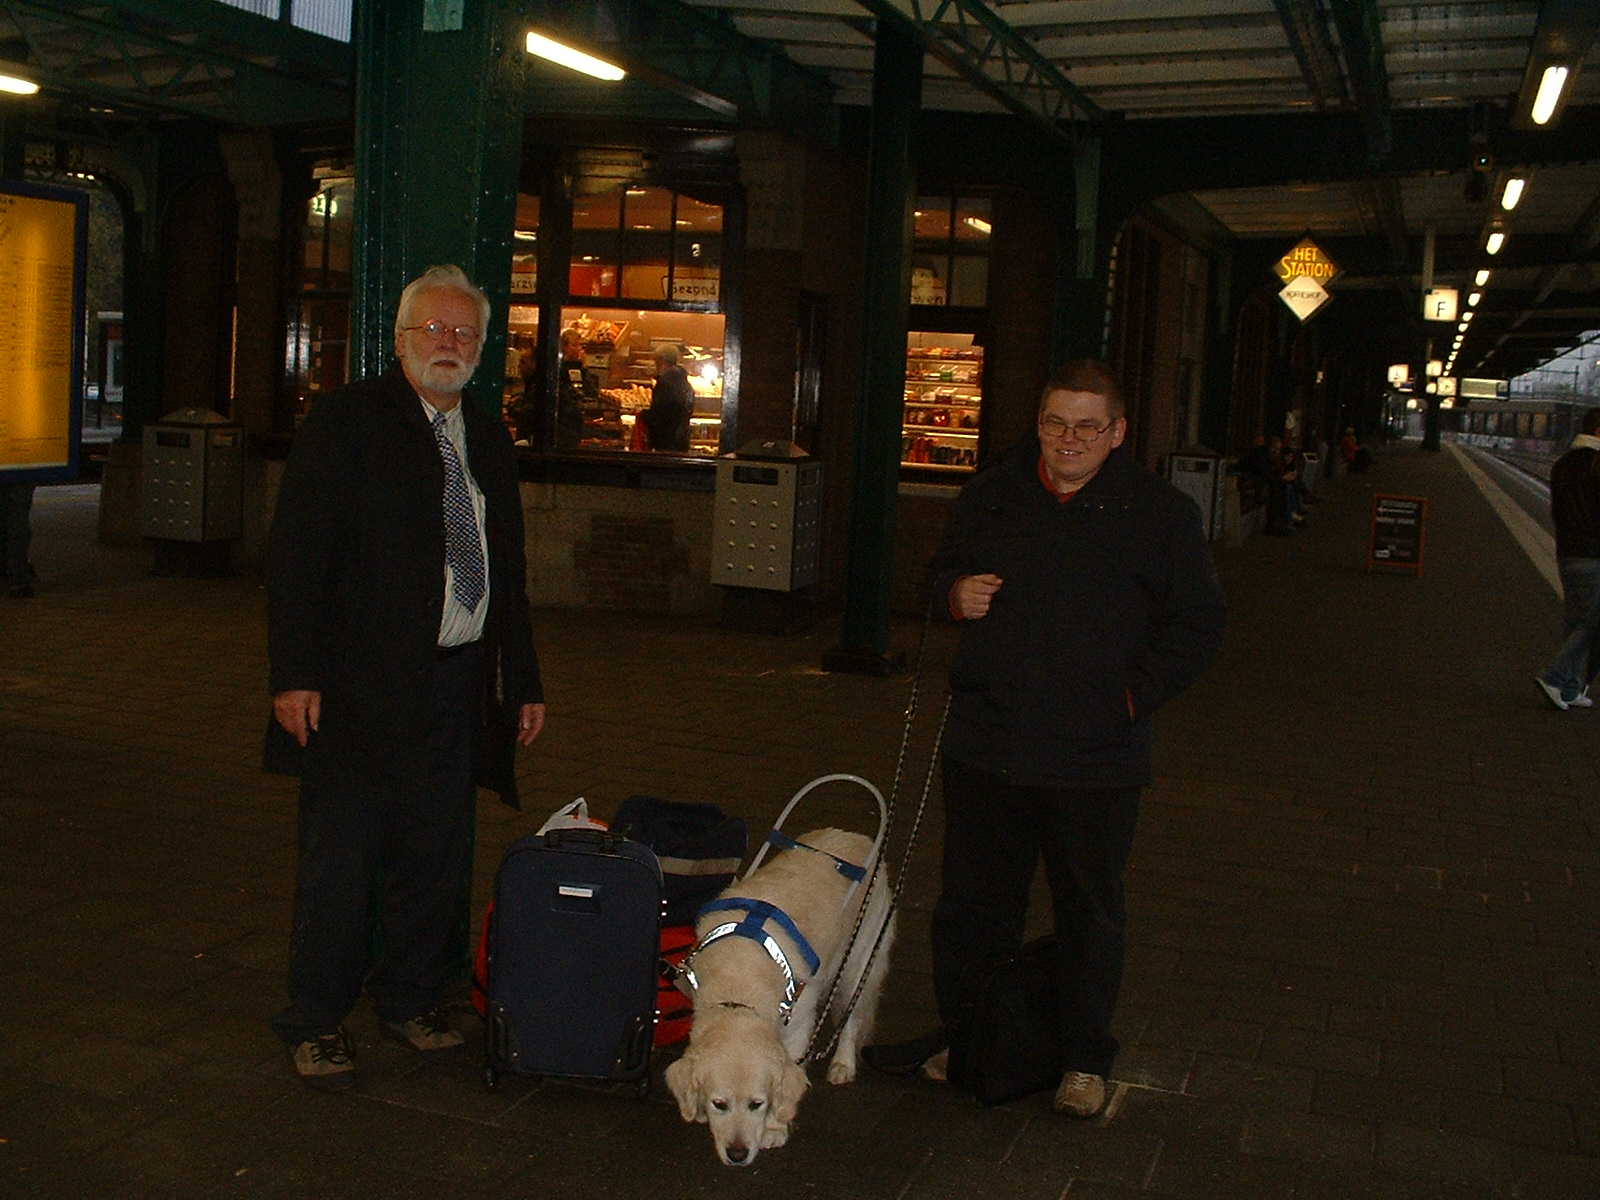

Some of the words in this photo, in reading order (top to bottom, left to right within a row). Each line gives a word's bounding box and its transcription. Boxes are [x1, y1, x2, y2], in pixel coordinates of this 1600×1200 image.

[1295, 247, 1318, 261] HET
[1281, 255, 1334, 279] STATION
[1436, 300, 1446, 318] F
